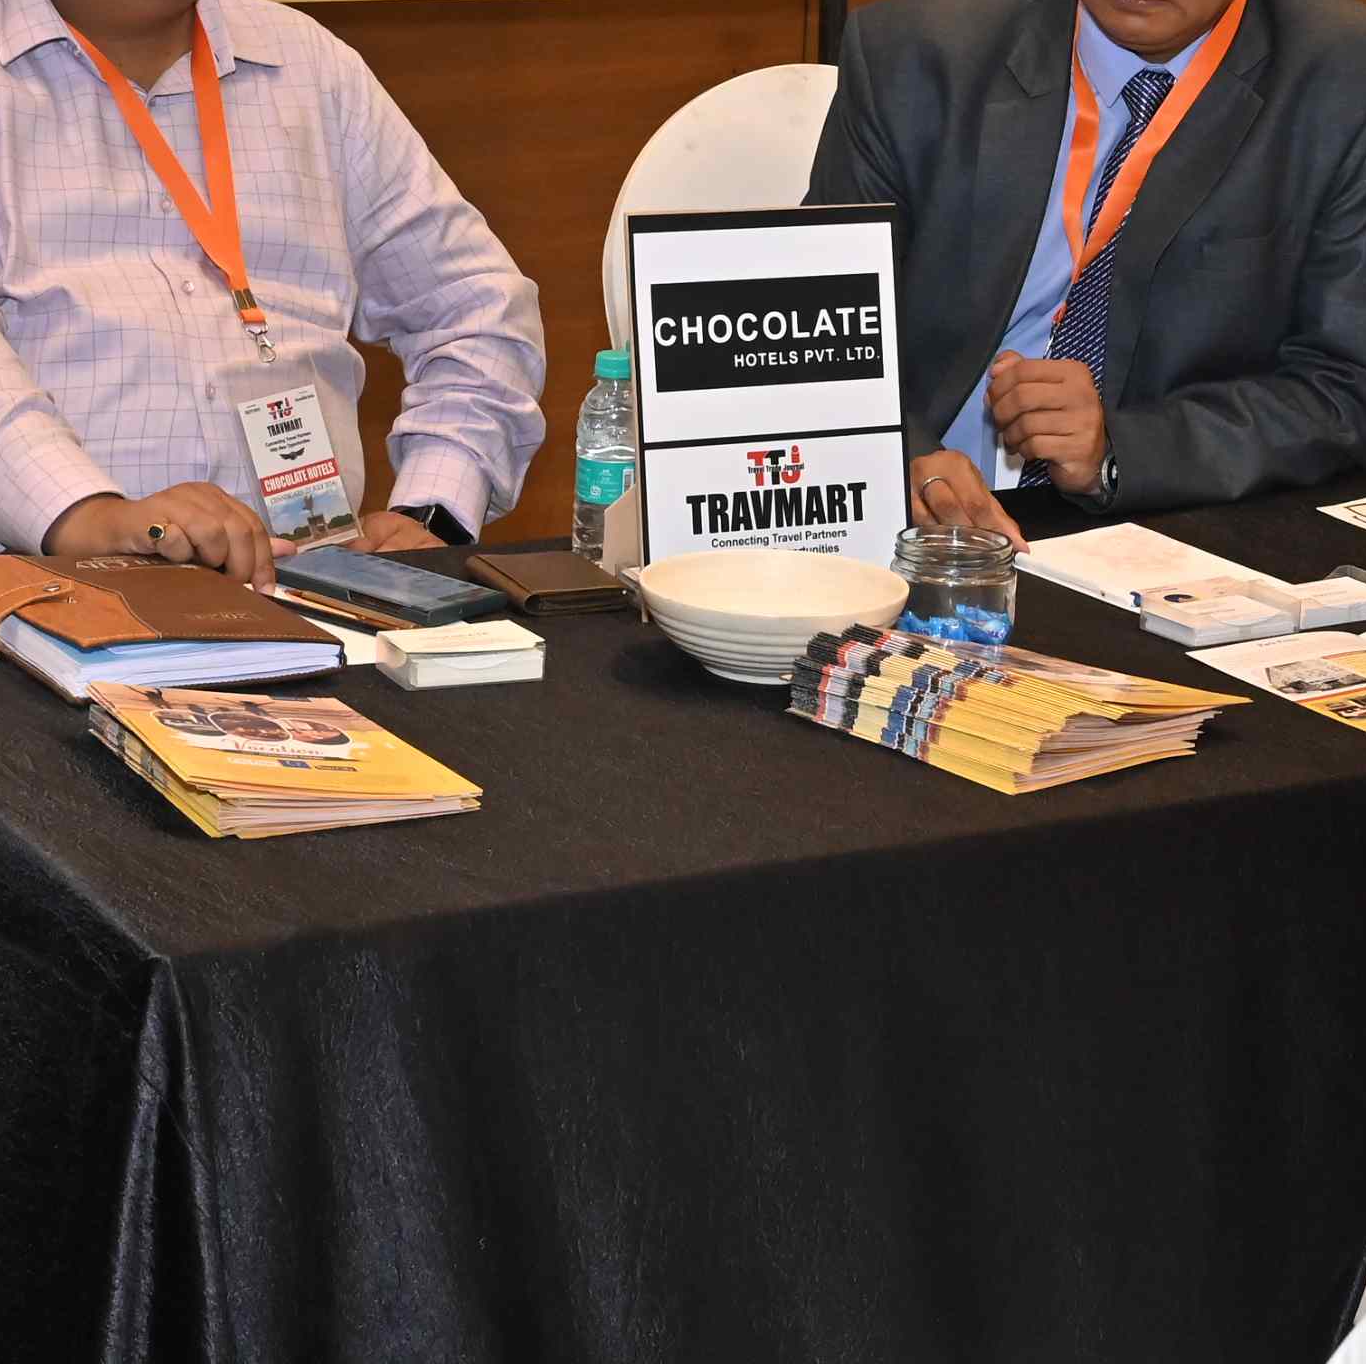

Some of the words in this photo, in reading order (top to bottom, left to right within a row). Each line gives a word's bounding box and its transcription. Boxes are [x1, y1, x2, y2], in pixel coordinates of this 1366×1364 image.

[653, 306, 881, 347] CHOCOLATE
[734, 350, 799, 368] HOTELS
[803, 348, 841, 365] PVT.
[846, 346, 881, 362] LTD.
[266, 417, 304, 437] TRAVMART
[263, 470, 308, 494] CHOCOLATE
[306, 460, 336, 481] HOTELS
[685, 481, 867, 535] TRAVMART
[711, 535, 770, 548] Connecting
[771, 531, 803, 544] Travel
[805, 528, 848, 541] Partners
